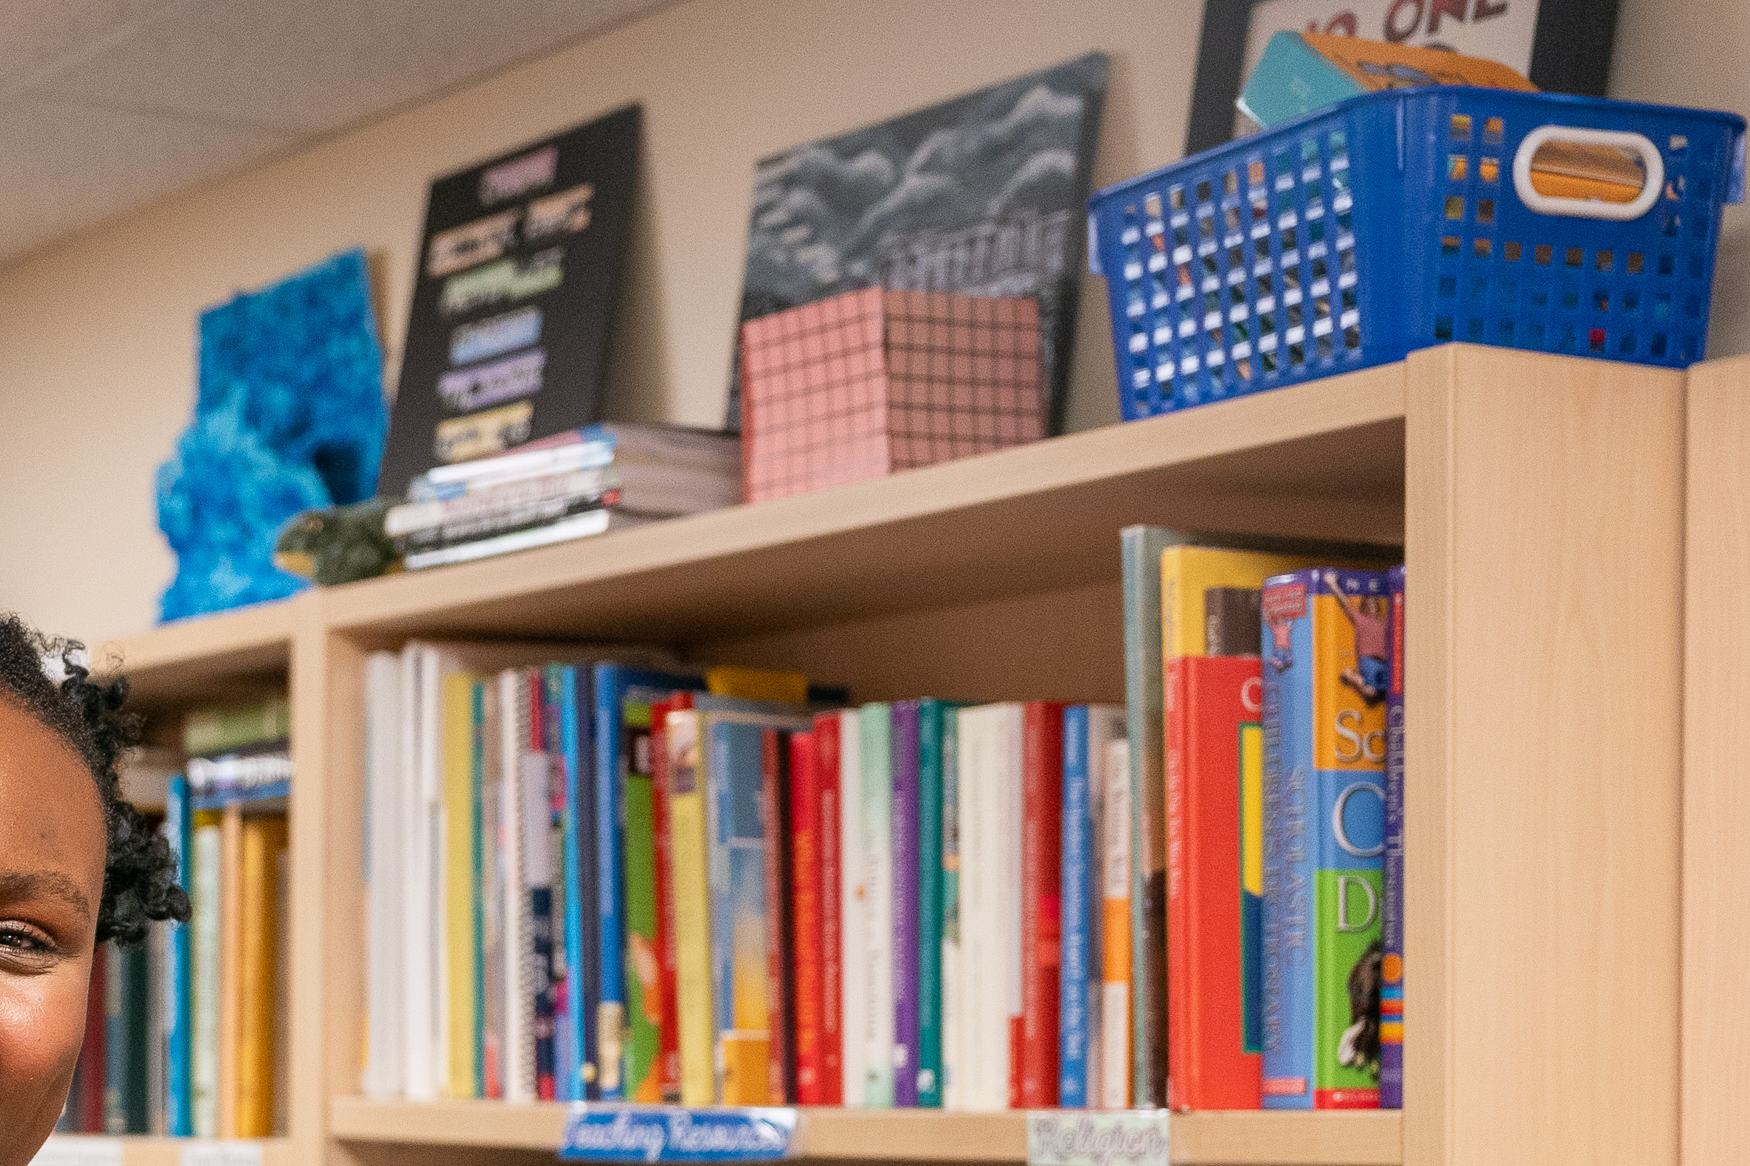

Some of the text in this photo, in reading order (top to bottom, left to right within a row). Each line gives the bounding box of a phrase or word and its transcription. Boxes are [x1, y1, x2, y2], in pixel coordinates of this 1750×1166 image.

[1262, 682, 1283, 1055] CHILDREN'S DICTIONARY
[1284, 768, 1308, 966] SCHOLASTIC
[1036, 1116, 1168, 1166] Religion
